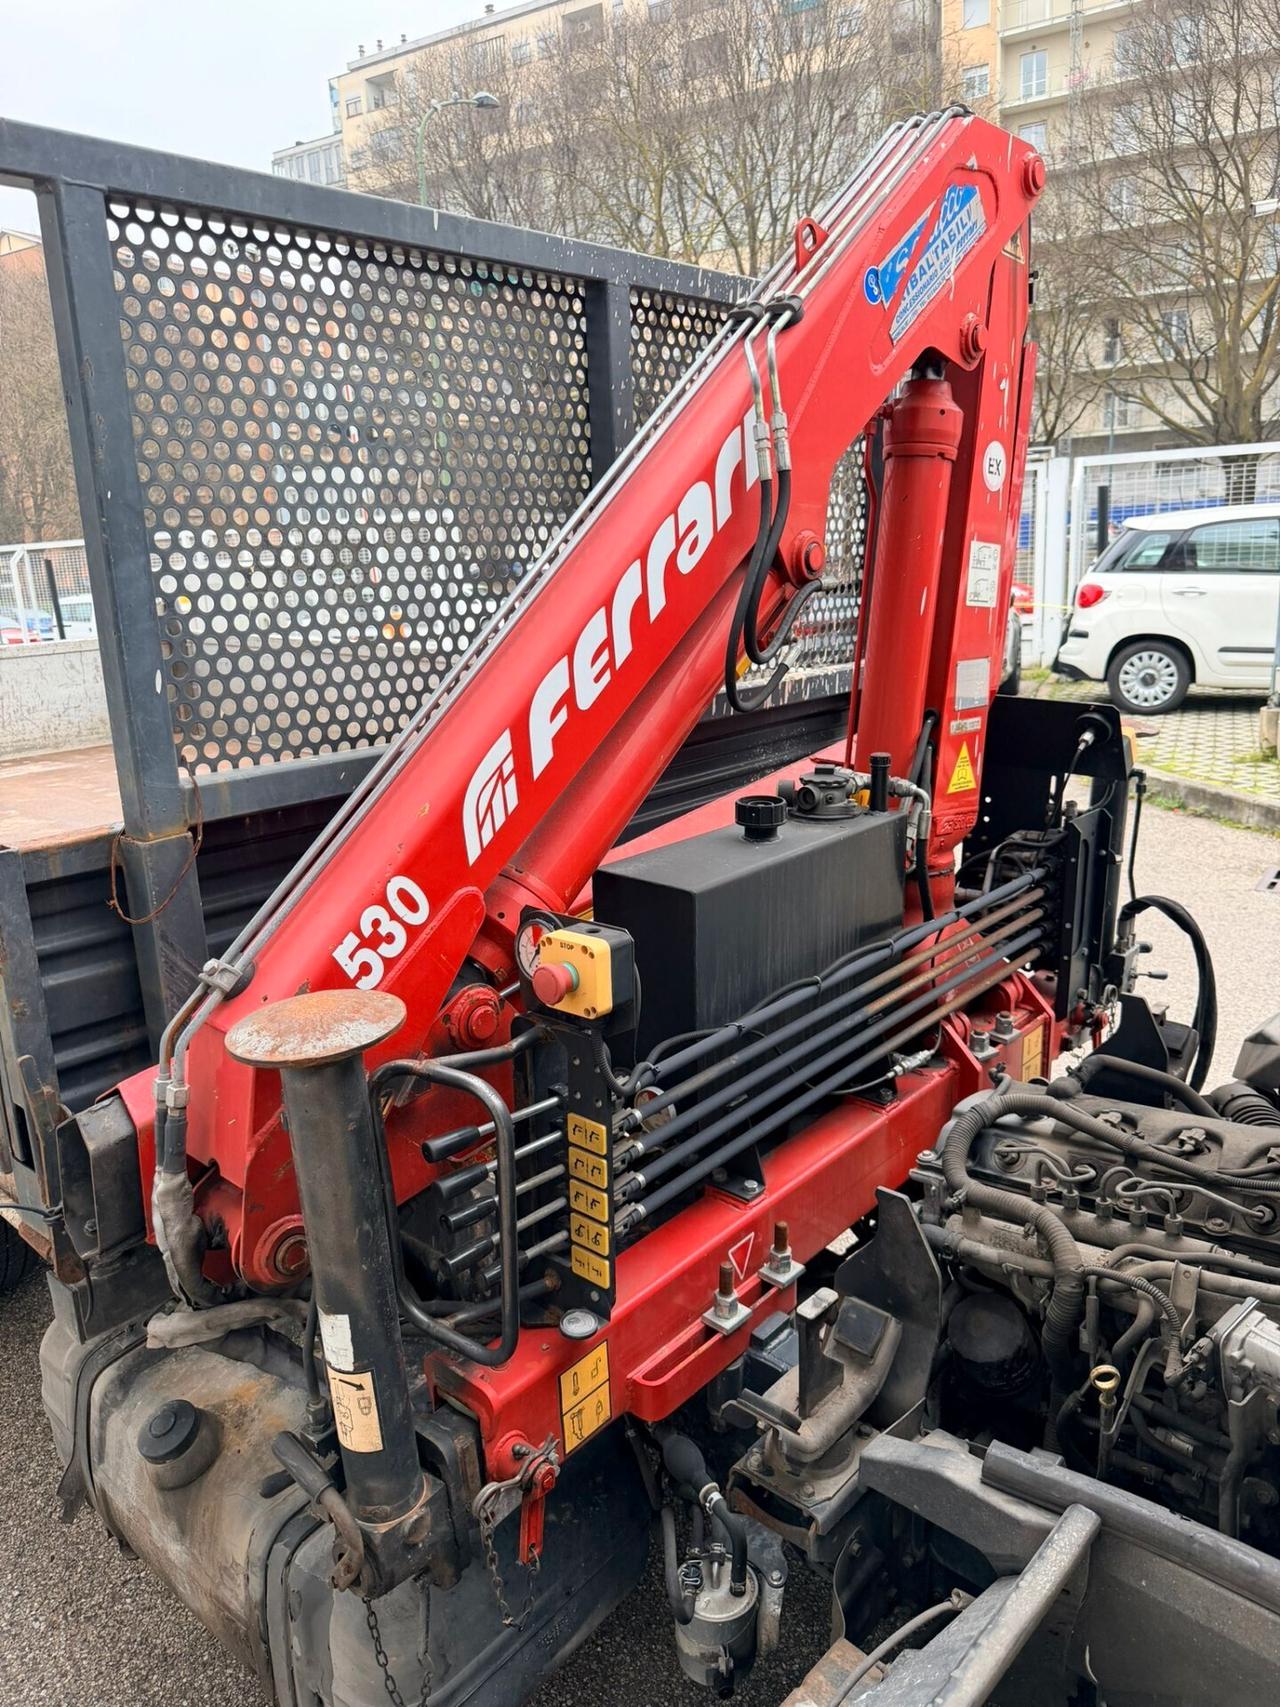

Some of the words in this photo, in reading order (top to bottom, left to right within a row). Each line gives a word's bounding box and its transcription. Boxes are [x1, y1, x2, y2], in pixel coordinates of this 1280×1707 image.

[903, 203, 973, 301] IBALTABILI
[988, 457, 1002, 477] EX
[332, 875, 430, 991] 530
[560, 942, 575, 950] STOP
